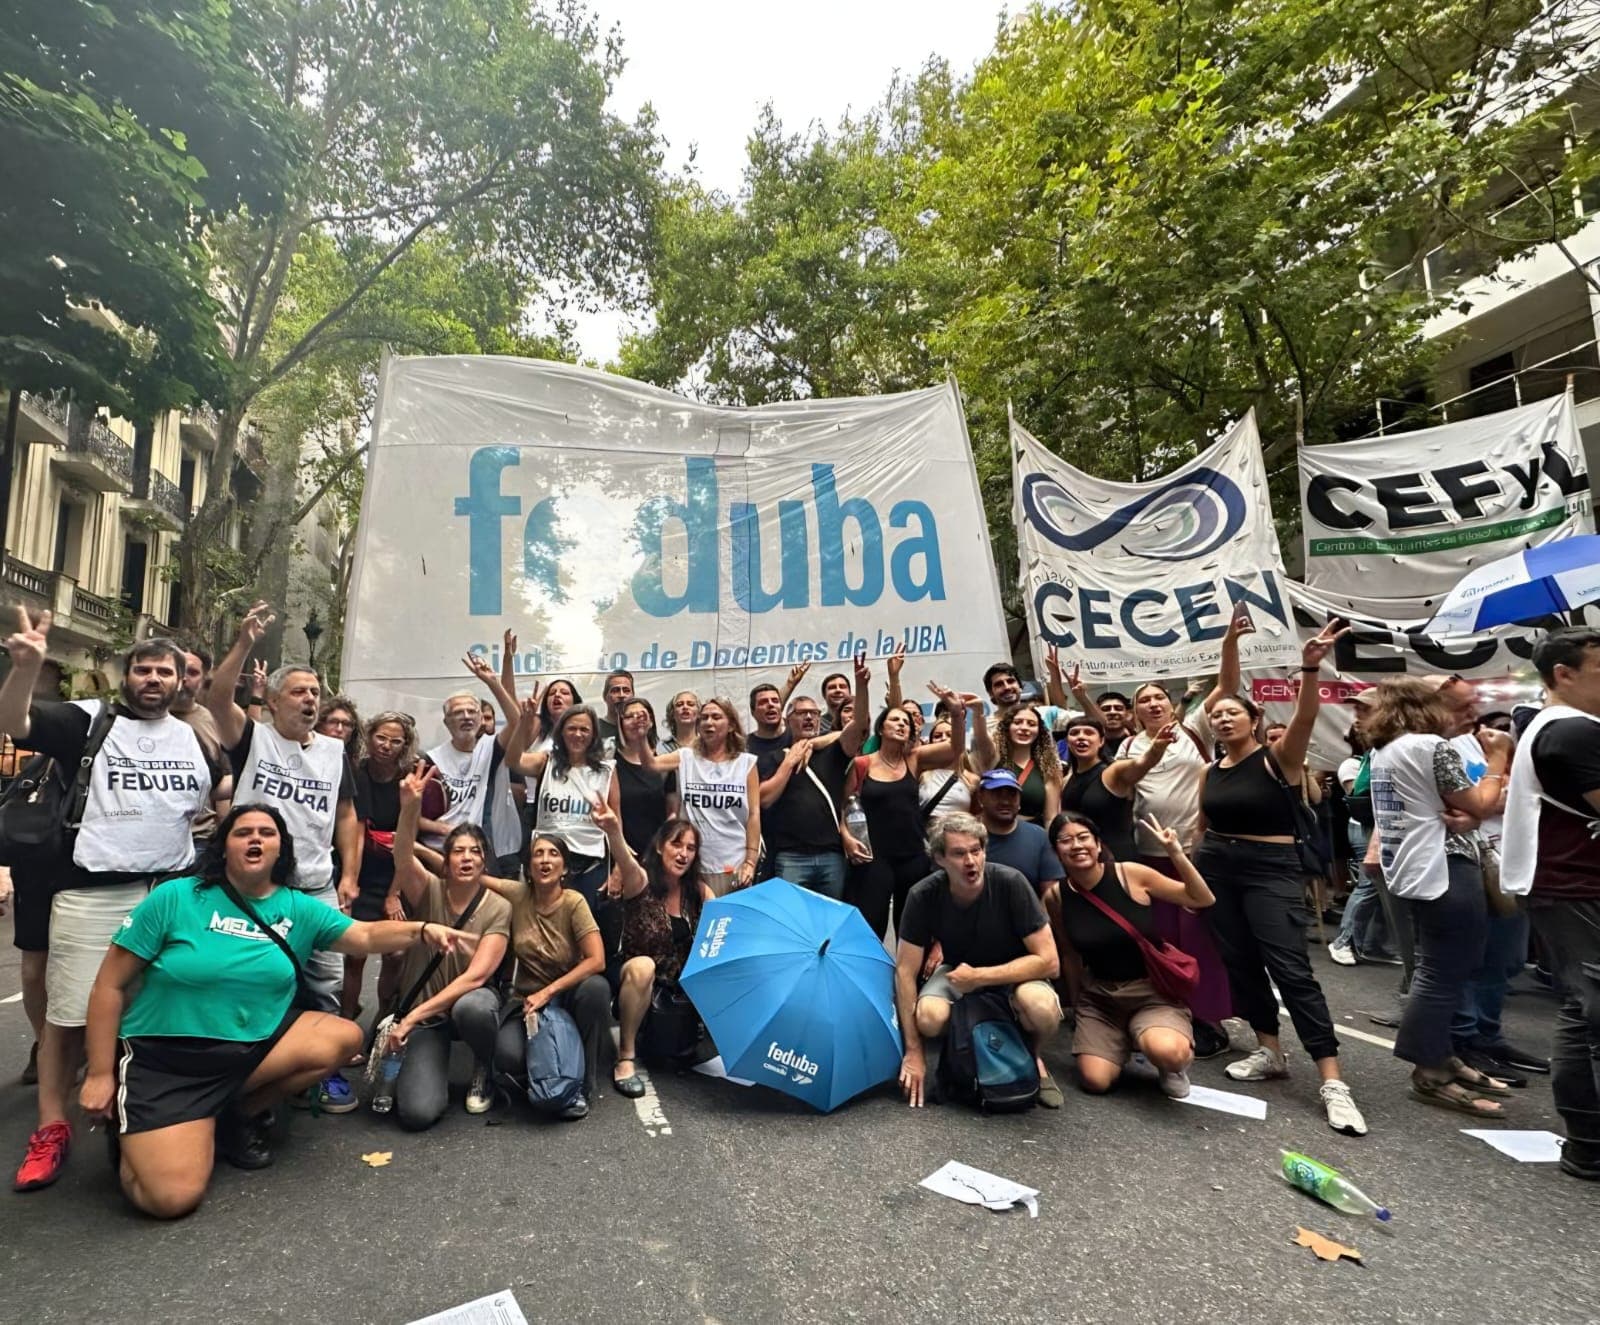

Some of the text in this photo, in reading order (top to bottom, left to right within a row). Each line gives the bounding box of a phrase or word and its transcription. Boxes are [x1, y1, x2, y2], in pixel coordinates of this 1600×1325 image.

[1316, 541, 1355, 552] Centro
[1034, 571, 1074, 589] nuevo
[1034, 570, 1290, 649] CECEN
[640, 642, 678, 669] de
[690, 637, 829, 668] Docentes
[838, 631, 868, 660] de
[875, 629, 894, 657] la
[904, 624, 947, 655] UBA
[1139, 658, 1150, 668] de
[107, 771, 199, 792] FEDUBA
[684, 793, 743, 809] FEDUBA
[708, 917, 732, 957] feduba
[768, 1041, 818, 1076] feduba
